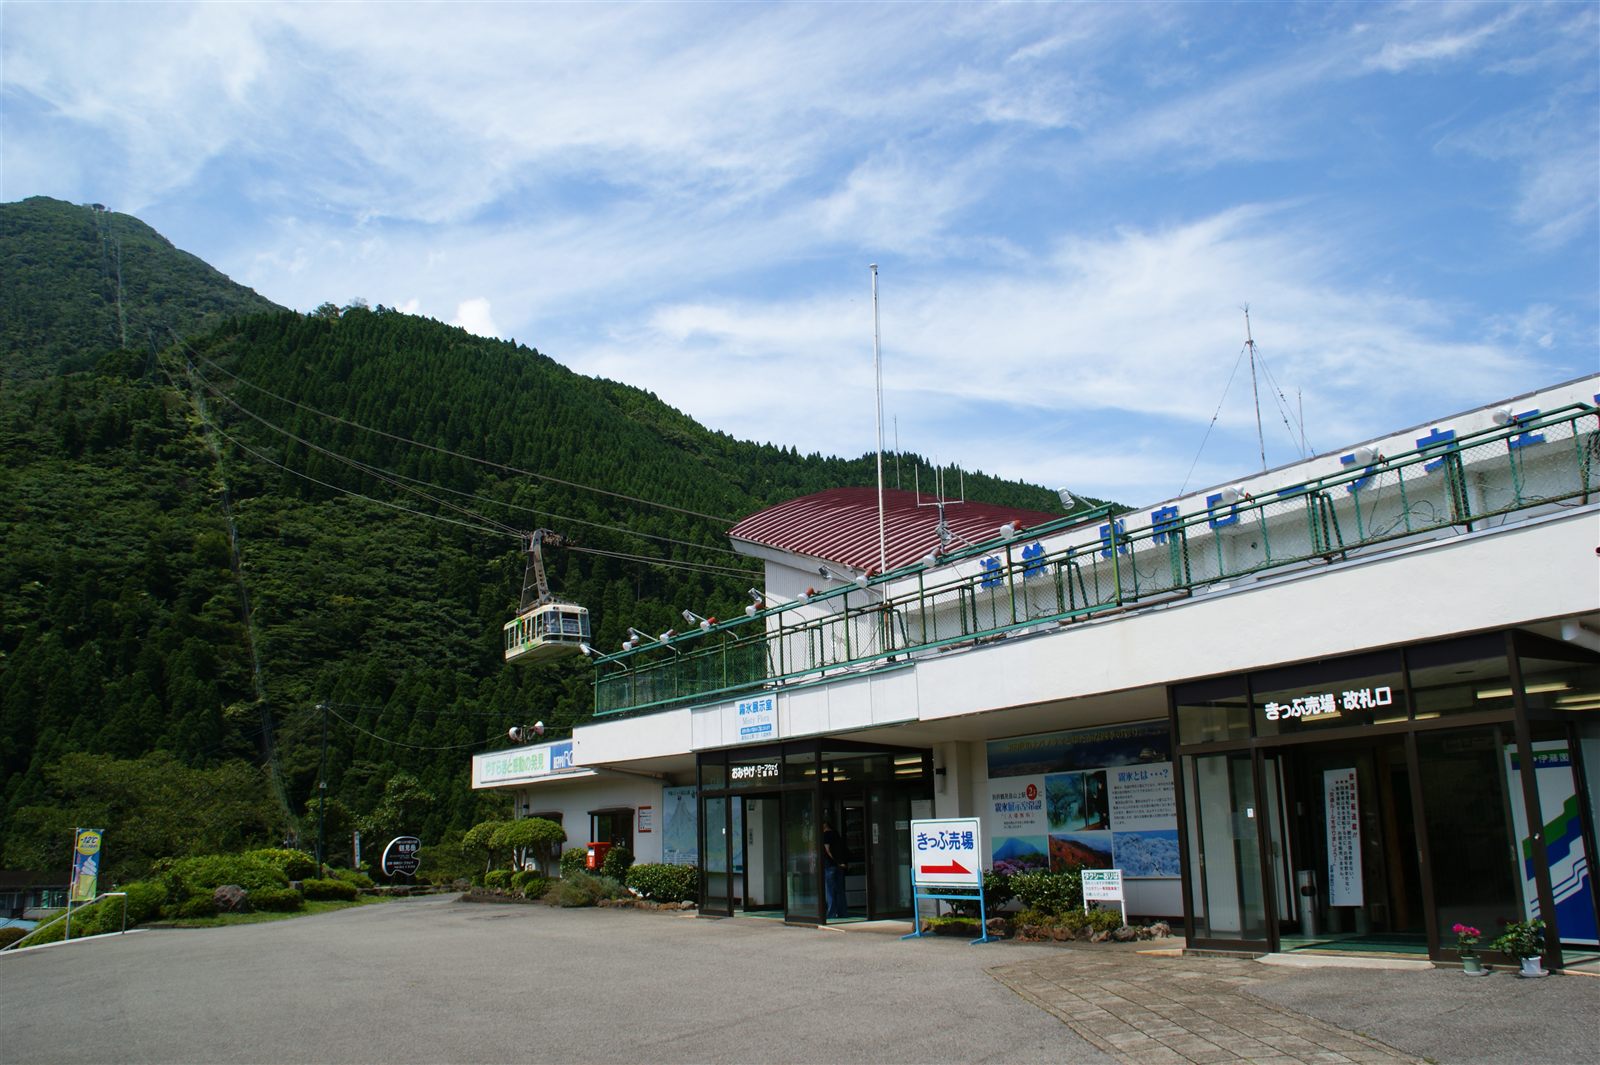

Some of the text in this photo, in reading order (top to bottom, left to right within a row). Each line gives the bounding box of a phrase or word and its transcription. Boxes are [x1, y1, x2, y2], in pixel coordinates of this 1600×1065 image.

[485, 753, 544, 777] やすらぎと感動の発見
[917, 830, 974, 850] きっぷ売場
